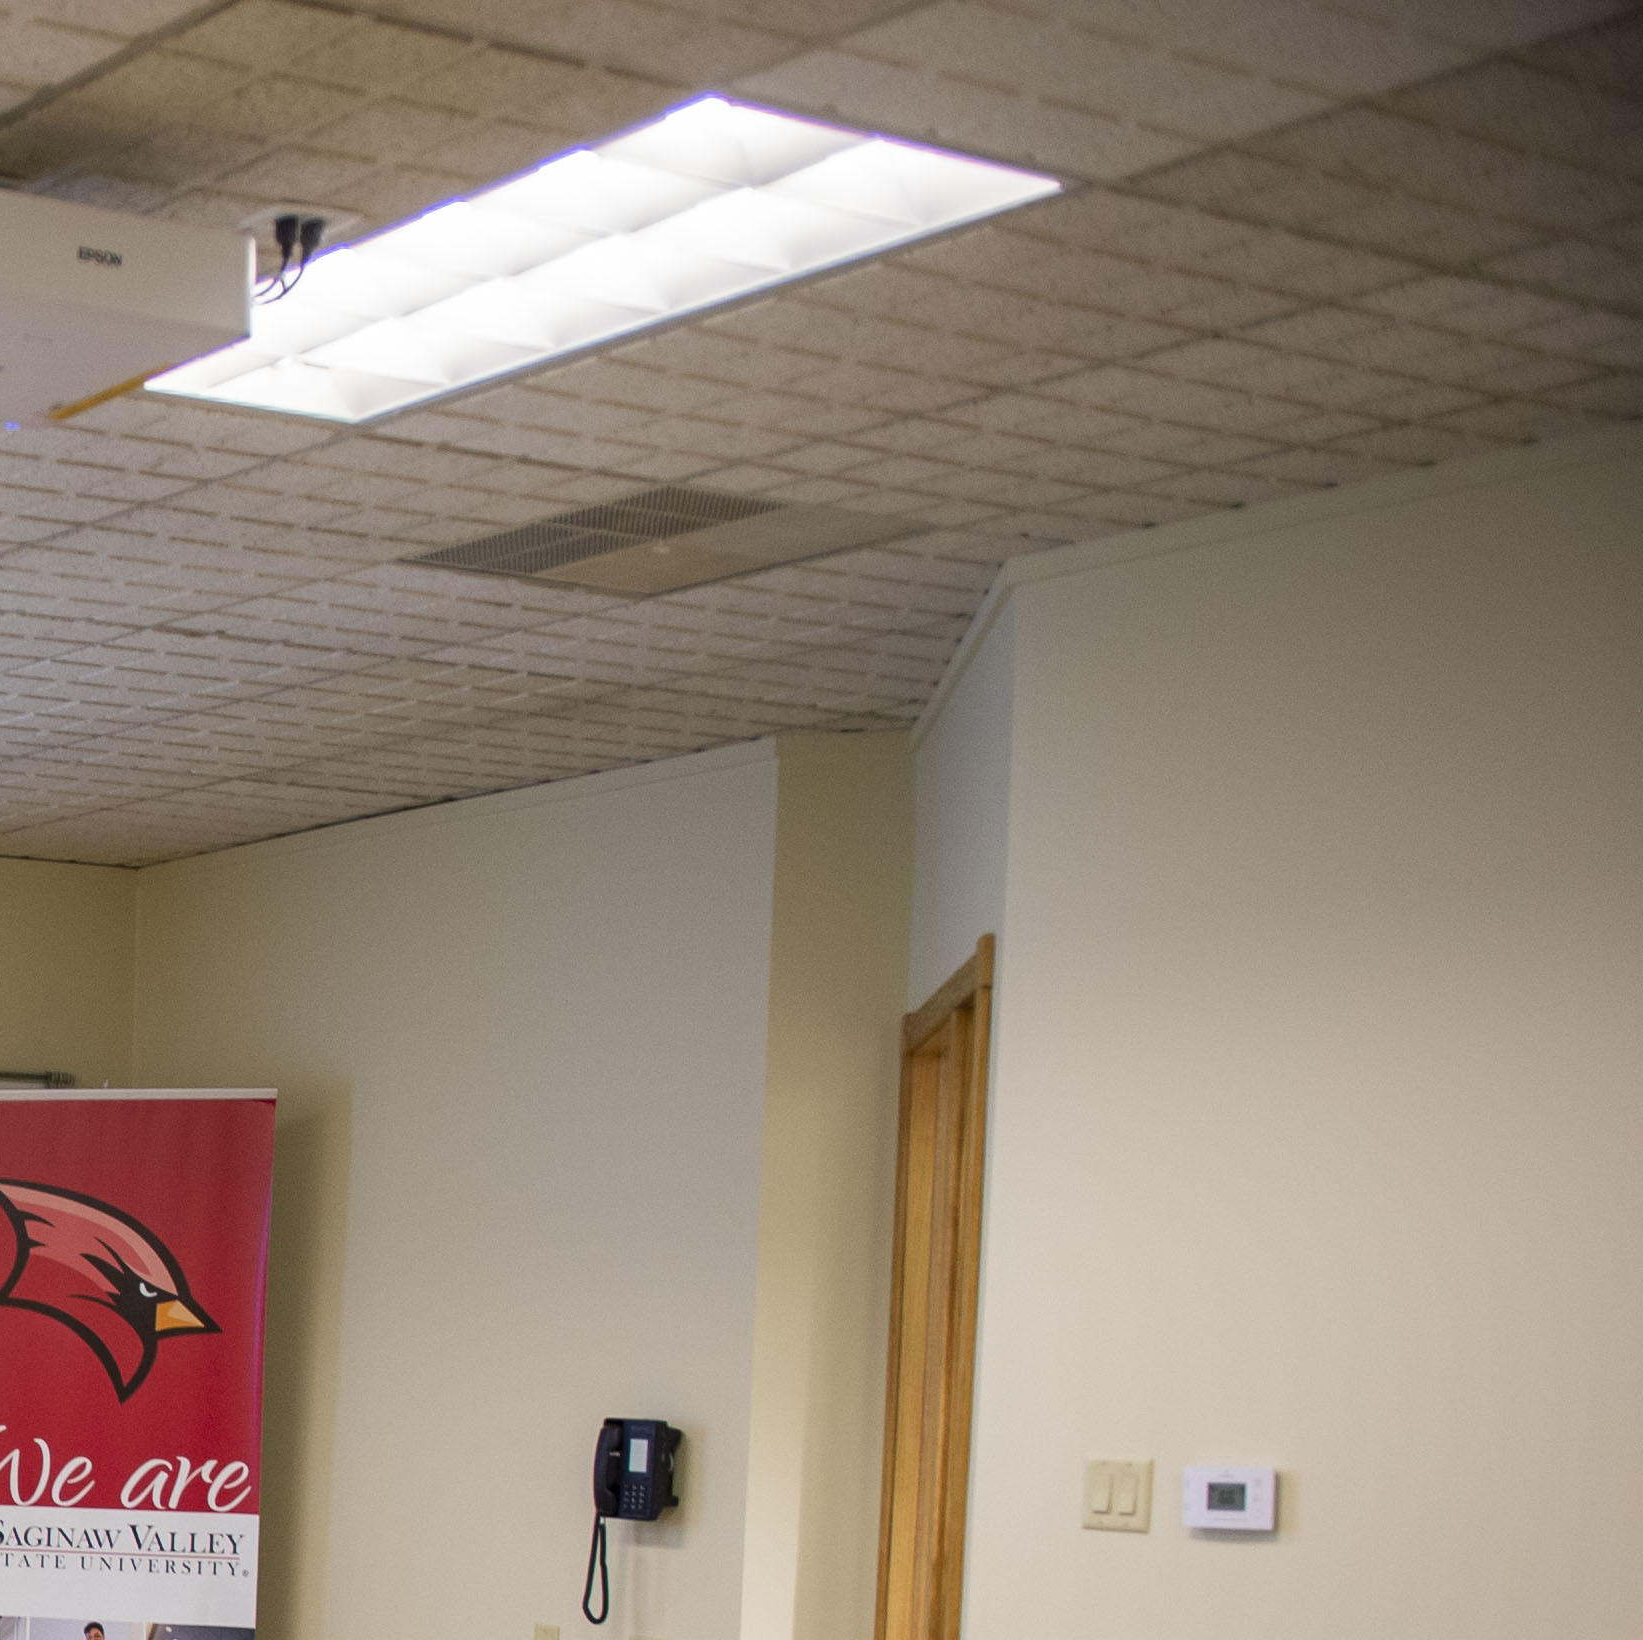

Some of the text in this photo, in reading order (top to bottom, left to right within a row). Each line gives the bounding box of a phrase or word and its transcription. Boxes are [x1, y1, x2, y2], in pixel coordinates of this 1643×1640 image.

[78, 245, 123, 266] EPSON
[120, 1456, 251, 1512] are
[129, 1524, 244, 1555] VALLEY
